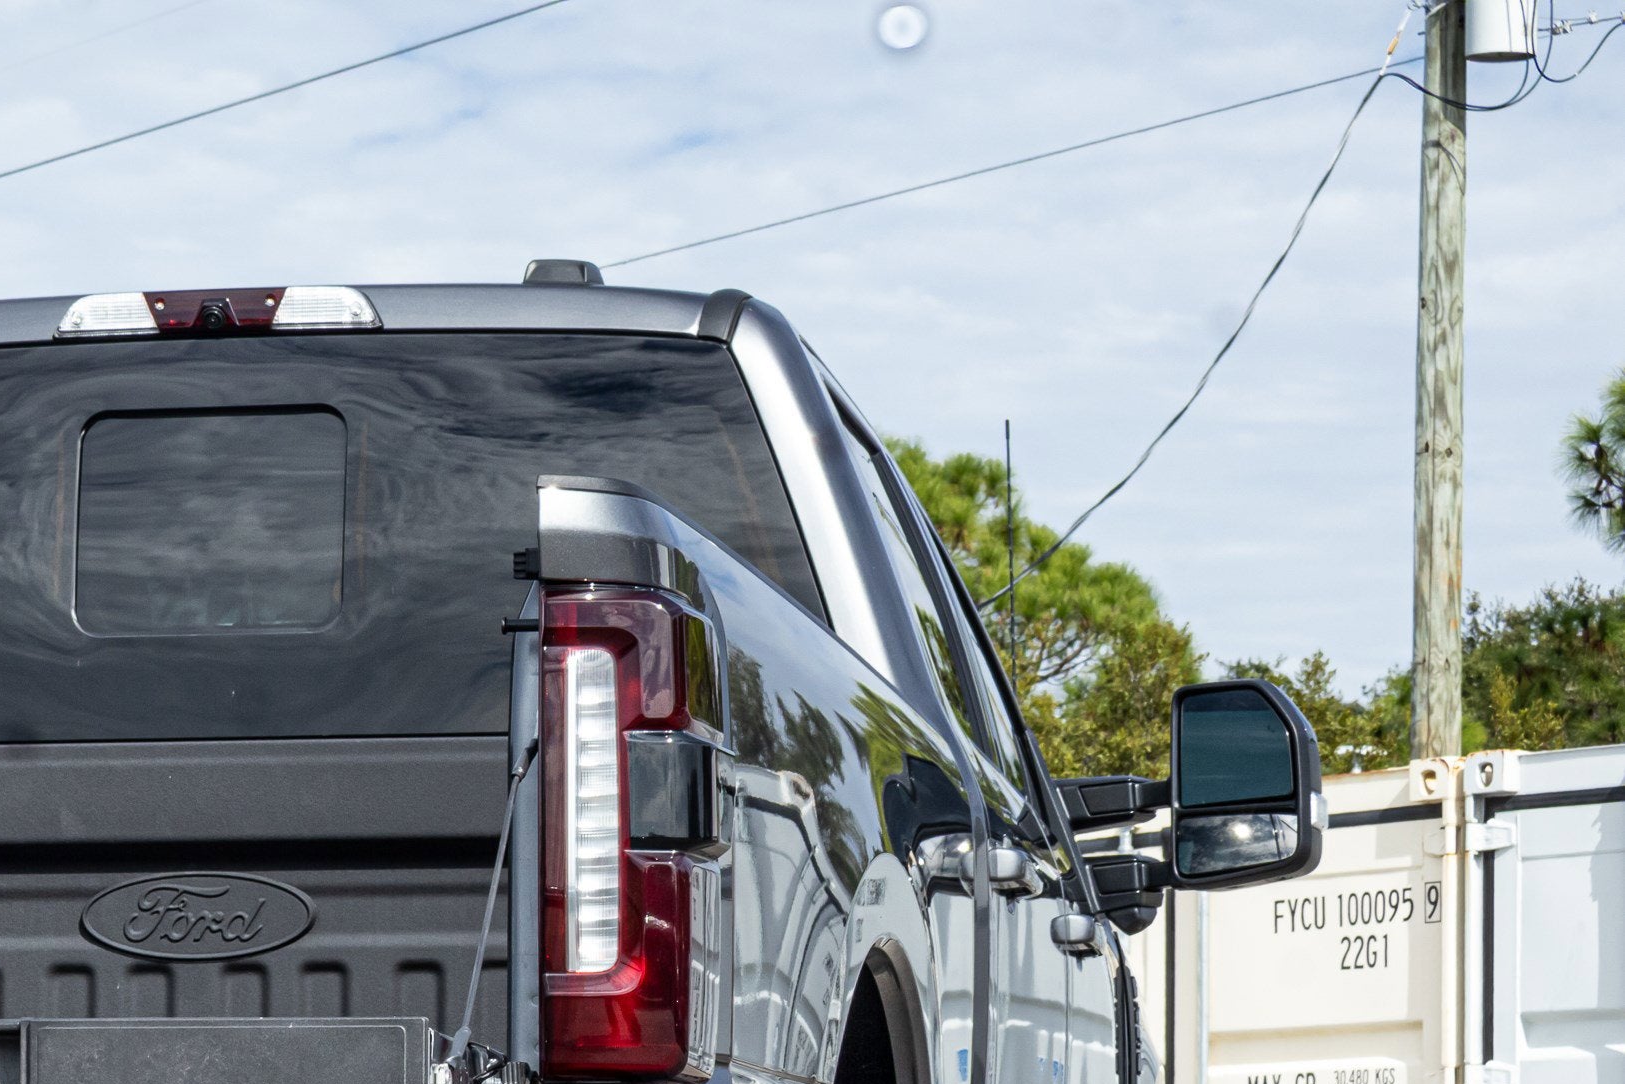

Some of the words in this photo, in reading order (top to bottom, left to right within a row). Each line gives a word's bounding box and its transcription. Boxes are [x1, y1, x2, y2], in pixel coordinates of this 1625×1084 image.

[123, 884, 266, 943] Ford
[1274, 896, 1326, 934] FYCU
[1337, 887, 1414, 928] 100095
[1426, 883, 1441, 921] 9
[1340, 934, 1388, 970] 22G1
